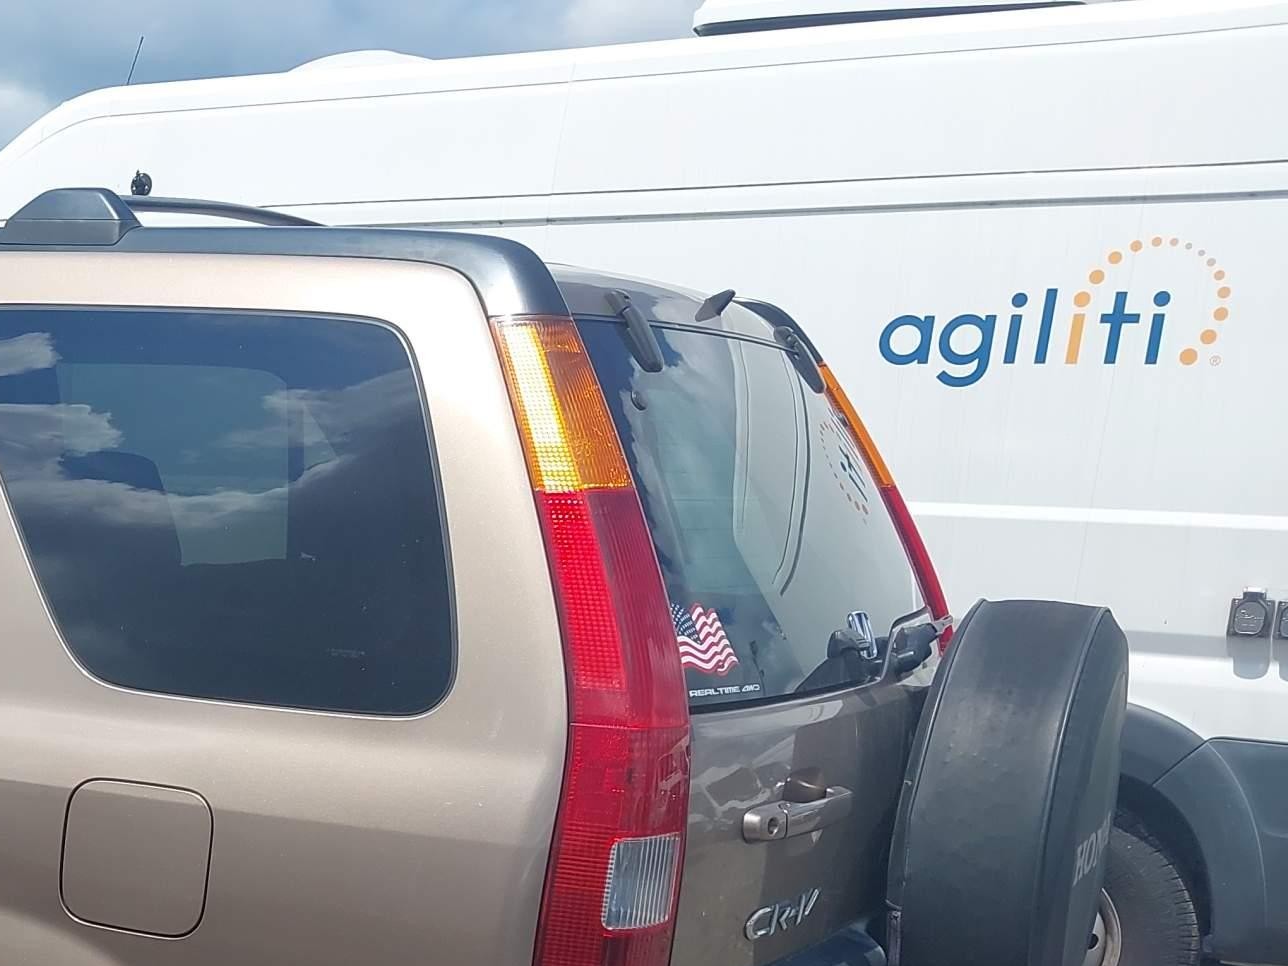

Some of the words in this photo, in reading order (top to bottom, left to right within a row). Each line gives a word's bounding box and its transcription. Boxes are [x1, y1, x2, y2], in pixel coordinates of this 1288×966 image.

[878, 288, 1172, 388] agiliti
[1072, 809, 1111, 889] HON
[745, 887, 822, 941] CR-V
